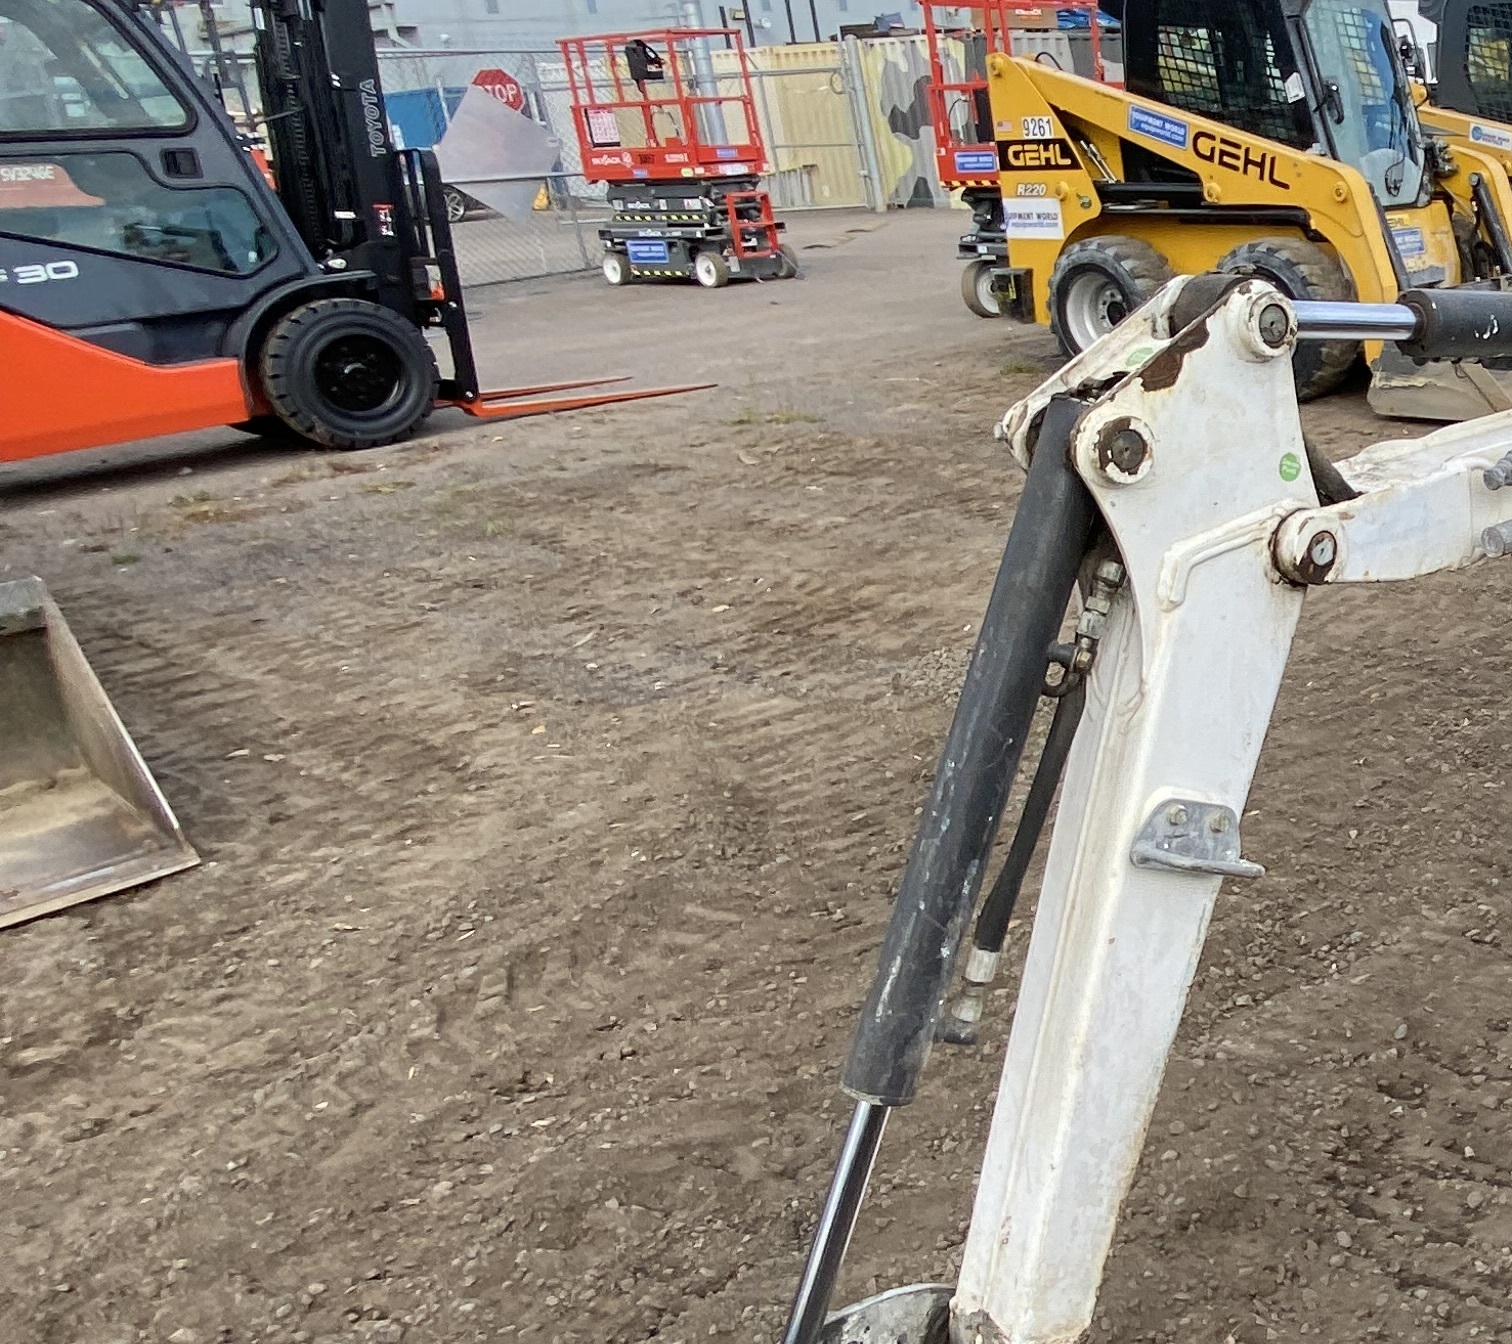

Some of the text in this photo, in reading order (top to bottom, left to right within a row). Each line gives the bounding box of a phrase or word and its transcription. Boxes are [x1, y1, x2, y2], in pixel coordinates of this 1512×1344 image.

[360, 79, 387, 157] TOYOTA
[1023, 118, 1052, 137] 9261
[1007, 143, 1072, 166] GEHL
[1192, 131, 1290, 190] GEHL
[1016, 183, 1047, 196] R220
